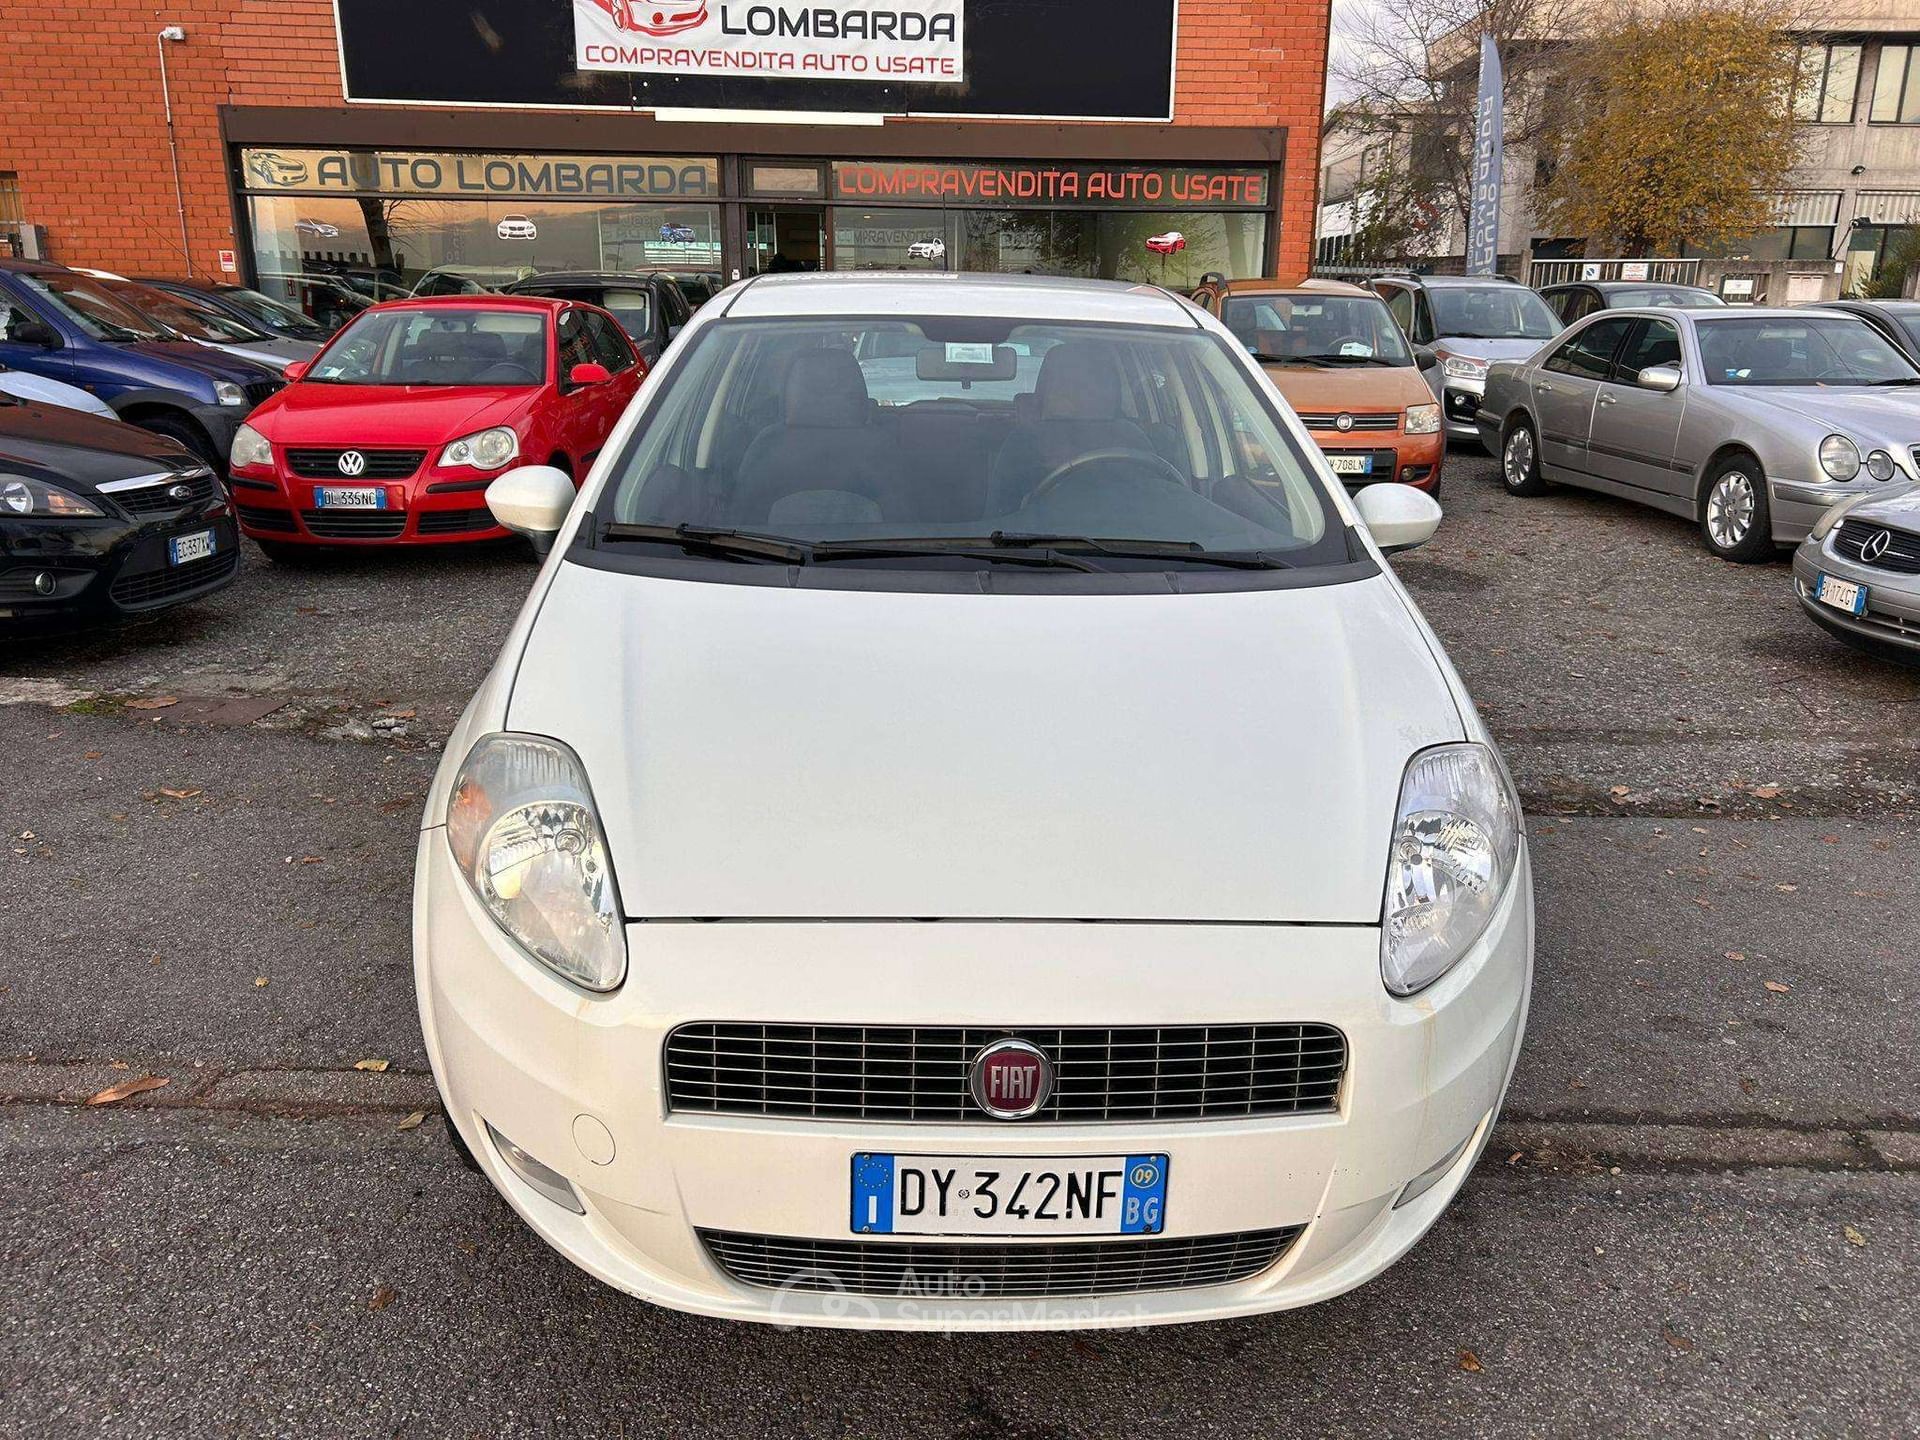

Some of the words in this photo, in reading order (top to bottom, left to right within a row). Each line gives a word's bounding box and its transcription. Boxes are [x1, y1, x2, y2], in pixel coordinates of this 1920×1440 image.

[721, 5, 955, 42] LOMBARDA
[585, 45, 795, 71] COMPRAVENDITA
[802, 53, 868, 72] AUTO
[876, 56, 955, 74] USATE
[318, 156, 443, 189] AUTO
[457, 158, 707, 194] LOMBARDA
[837, 166, 1079, 198] COMPRAVENDITA
[1087, 172, 1162, 199] AUTO
[1171, 173, 1261, 202] USATE
[990, 1065, 1037, 1099] FIAT
[1135, 1168, 1154, 1184] 09
[1126, 1197, 1159, 1224] BG
